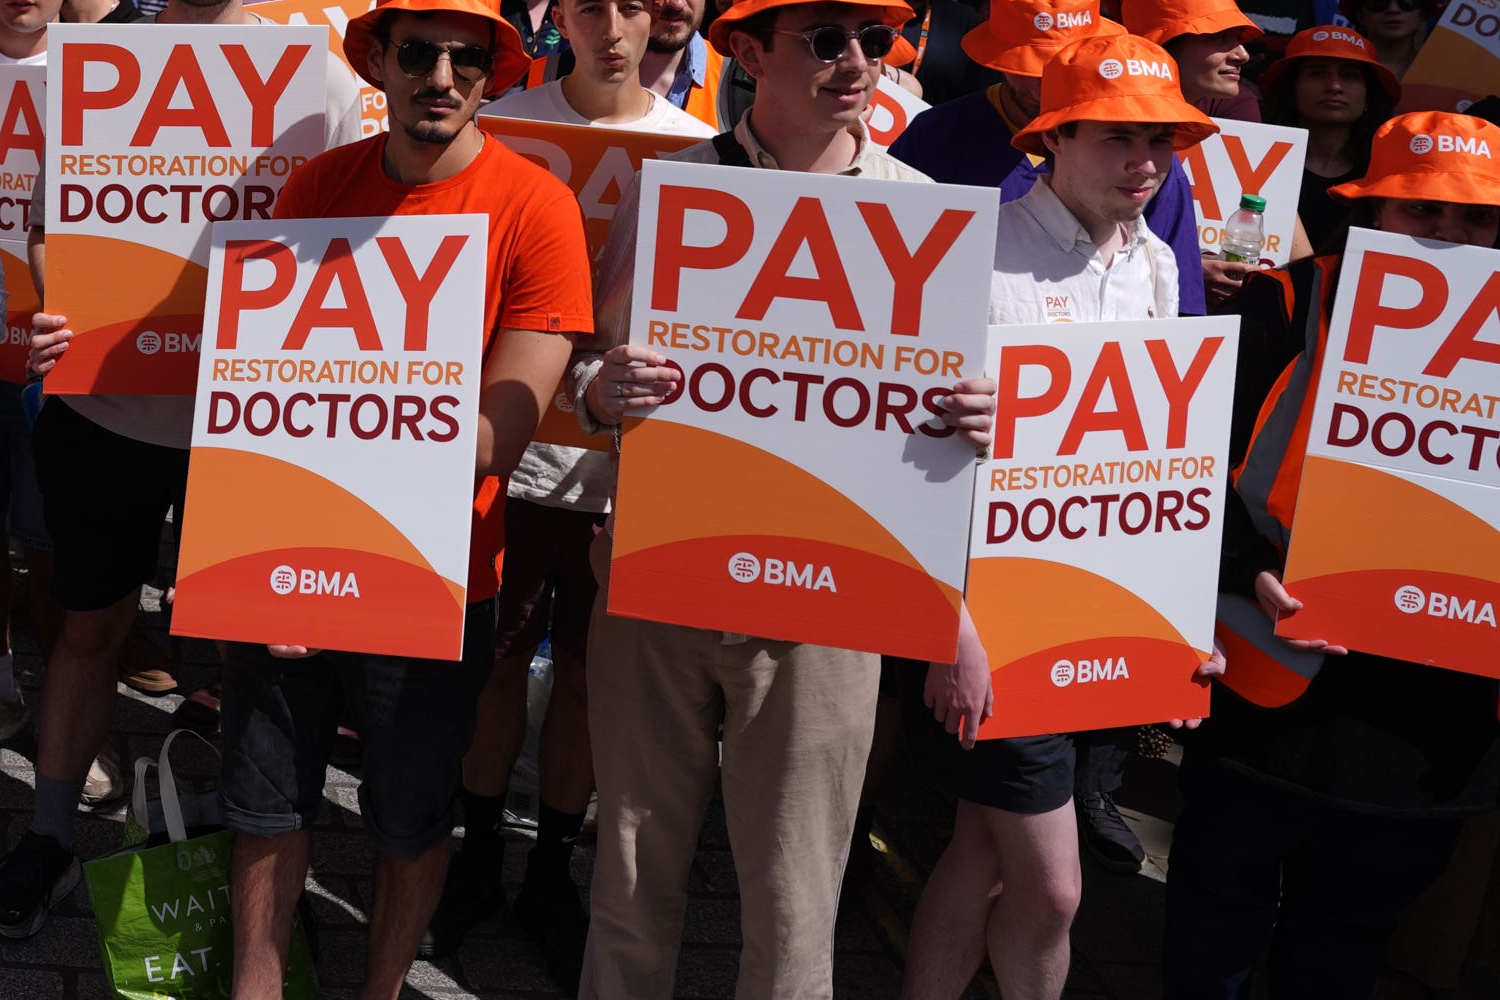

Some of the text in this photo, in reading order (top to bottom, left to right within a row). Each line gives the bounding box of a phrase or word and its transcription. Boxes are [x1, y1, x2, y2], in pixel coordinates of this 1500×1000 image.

[1056, 10, 1093, 29] BMA
[1331, 31, 1365, 49] BMA
[1127, 59, 1173, 81] BMA
[61, 43, 312, 148] PAY
[1437, 135, 1492, 159] BMA
[60, 154, 247, 177] RESTORATION
[59, 183, 284, 224] DOCTOR
[650, 184, 977, 337] PAY
[216, 235, 470, 351] PAY
[1045, 296, 1068, 308] PAY
[165, 333, 201, 353] BM
[647, 319, 965, 378] RESTORATION FOR
[212, 358, 464, 386] RESTORATION FOR
[993, 336, 1226, 460] PAY
[1337, 370, 1500, 420] RESTORAT
[207, 391, 460, 443] DOCTORS
[1326, 403, 1500, 472] DOCT
[989, 455, 1215, 492] RESTORATION FOR
[986, 487, 1212, 545] DOCTORS
[299, 569, 360, 598] BMA
[764, 558, 837, 593] BMA
[1428, 592, 1497, 628] BMA
[1076, 656, 1130, 684] BMA
[152, 885, 230, 923] WAIT
